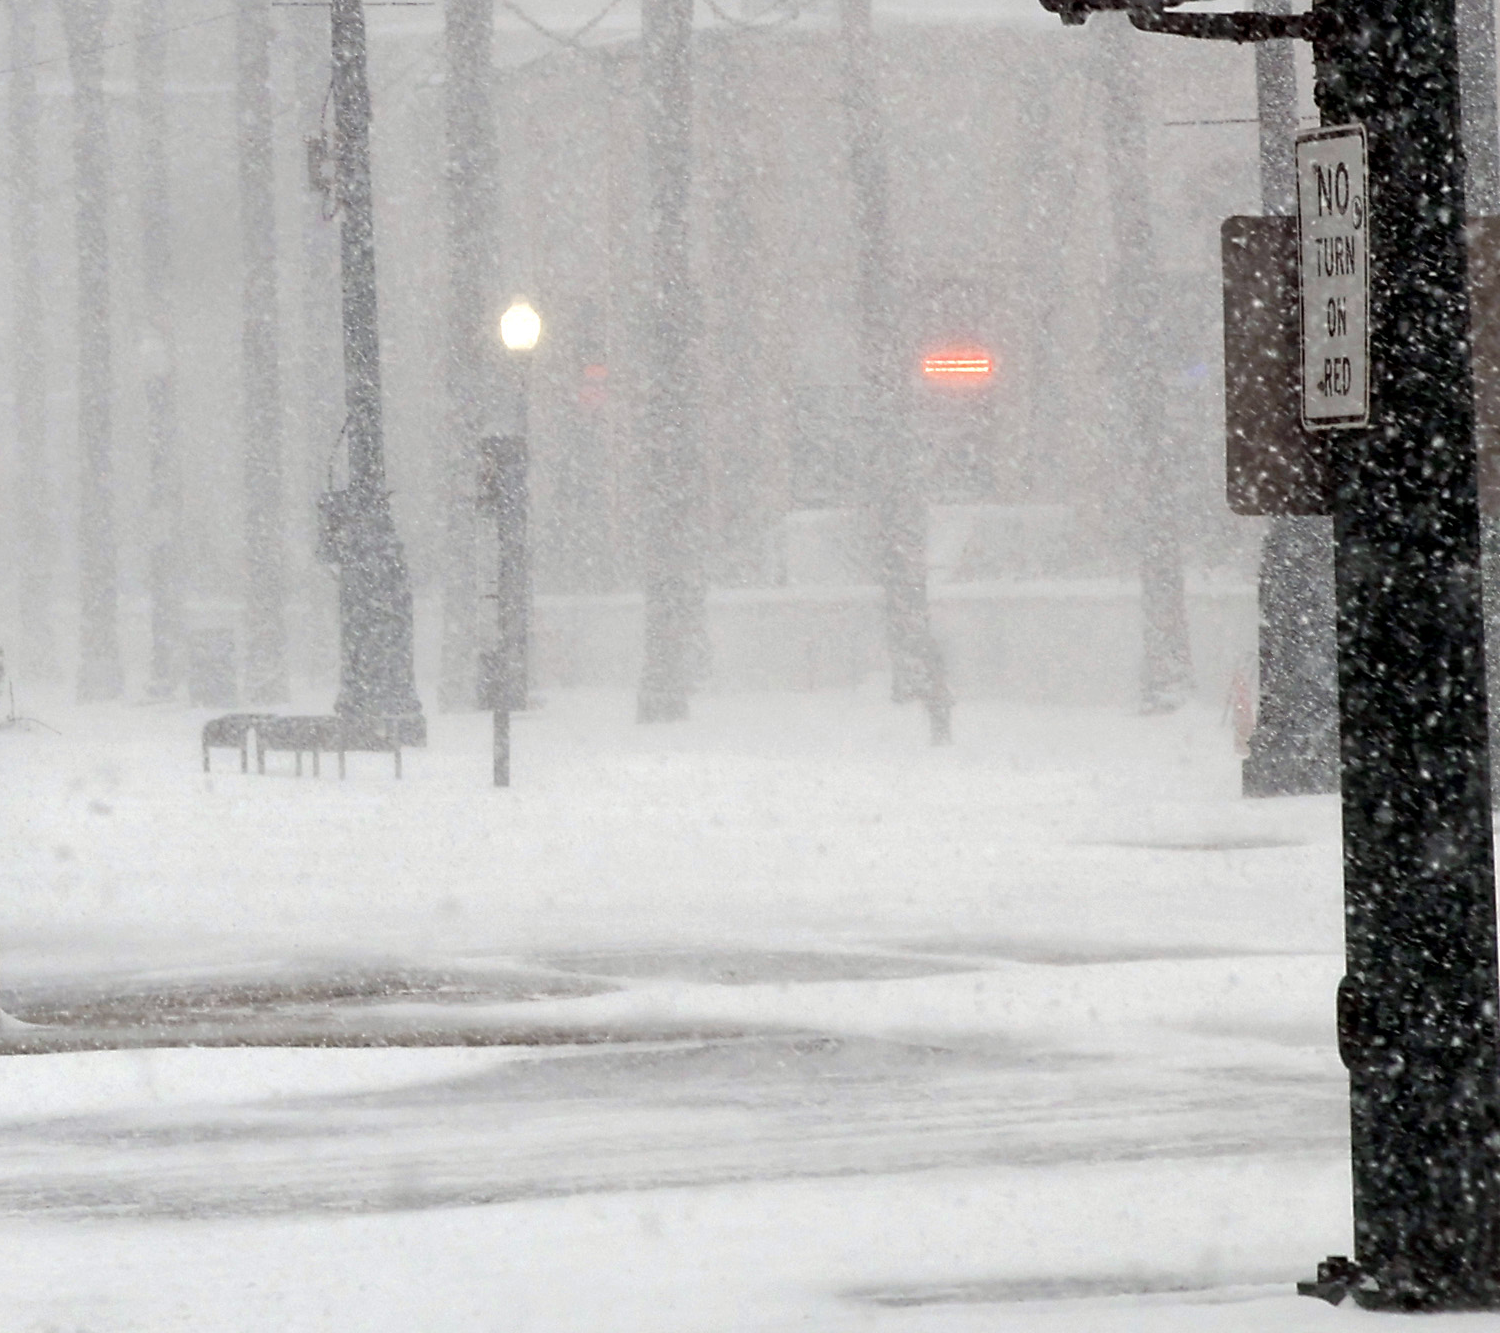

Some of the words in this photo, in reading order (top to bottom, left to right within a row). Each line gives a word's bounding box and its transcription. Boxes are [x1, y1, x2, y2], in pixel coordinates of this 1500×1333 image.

[1316, 161, 1351, 217] NO
[1314, 236, 1357, 277] TURN
[1327, 296, 1348, 338] ON
[1323, 357, 1352, 399] RED
